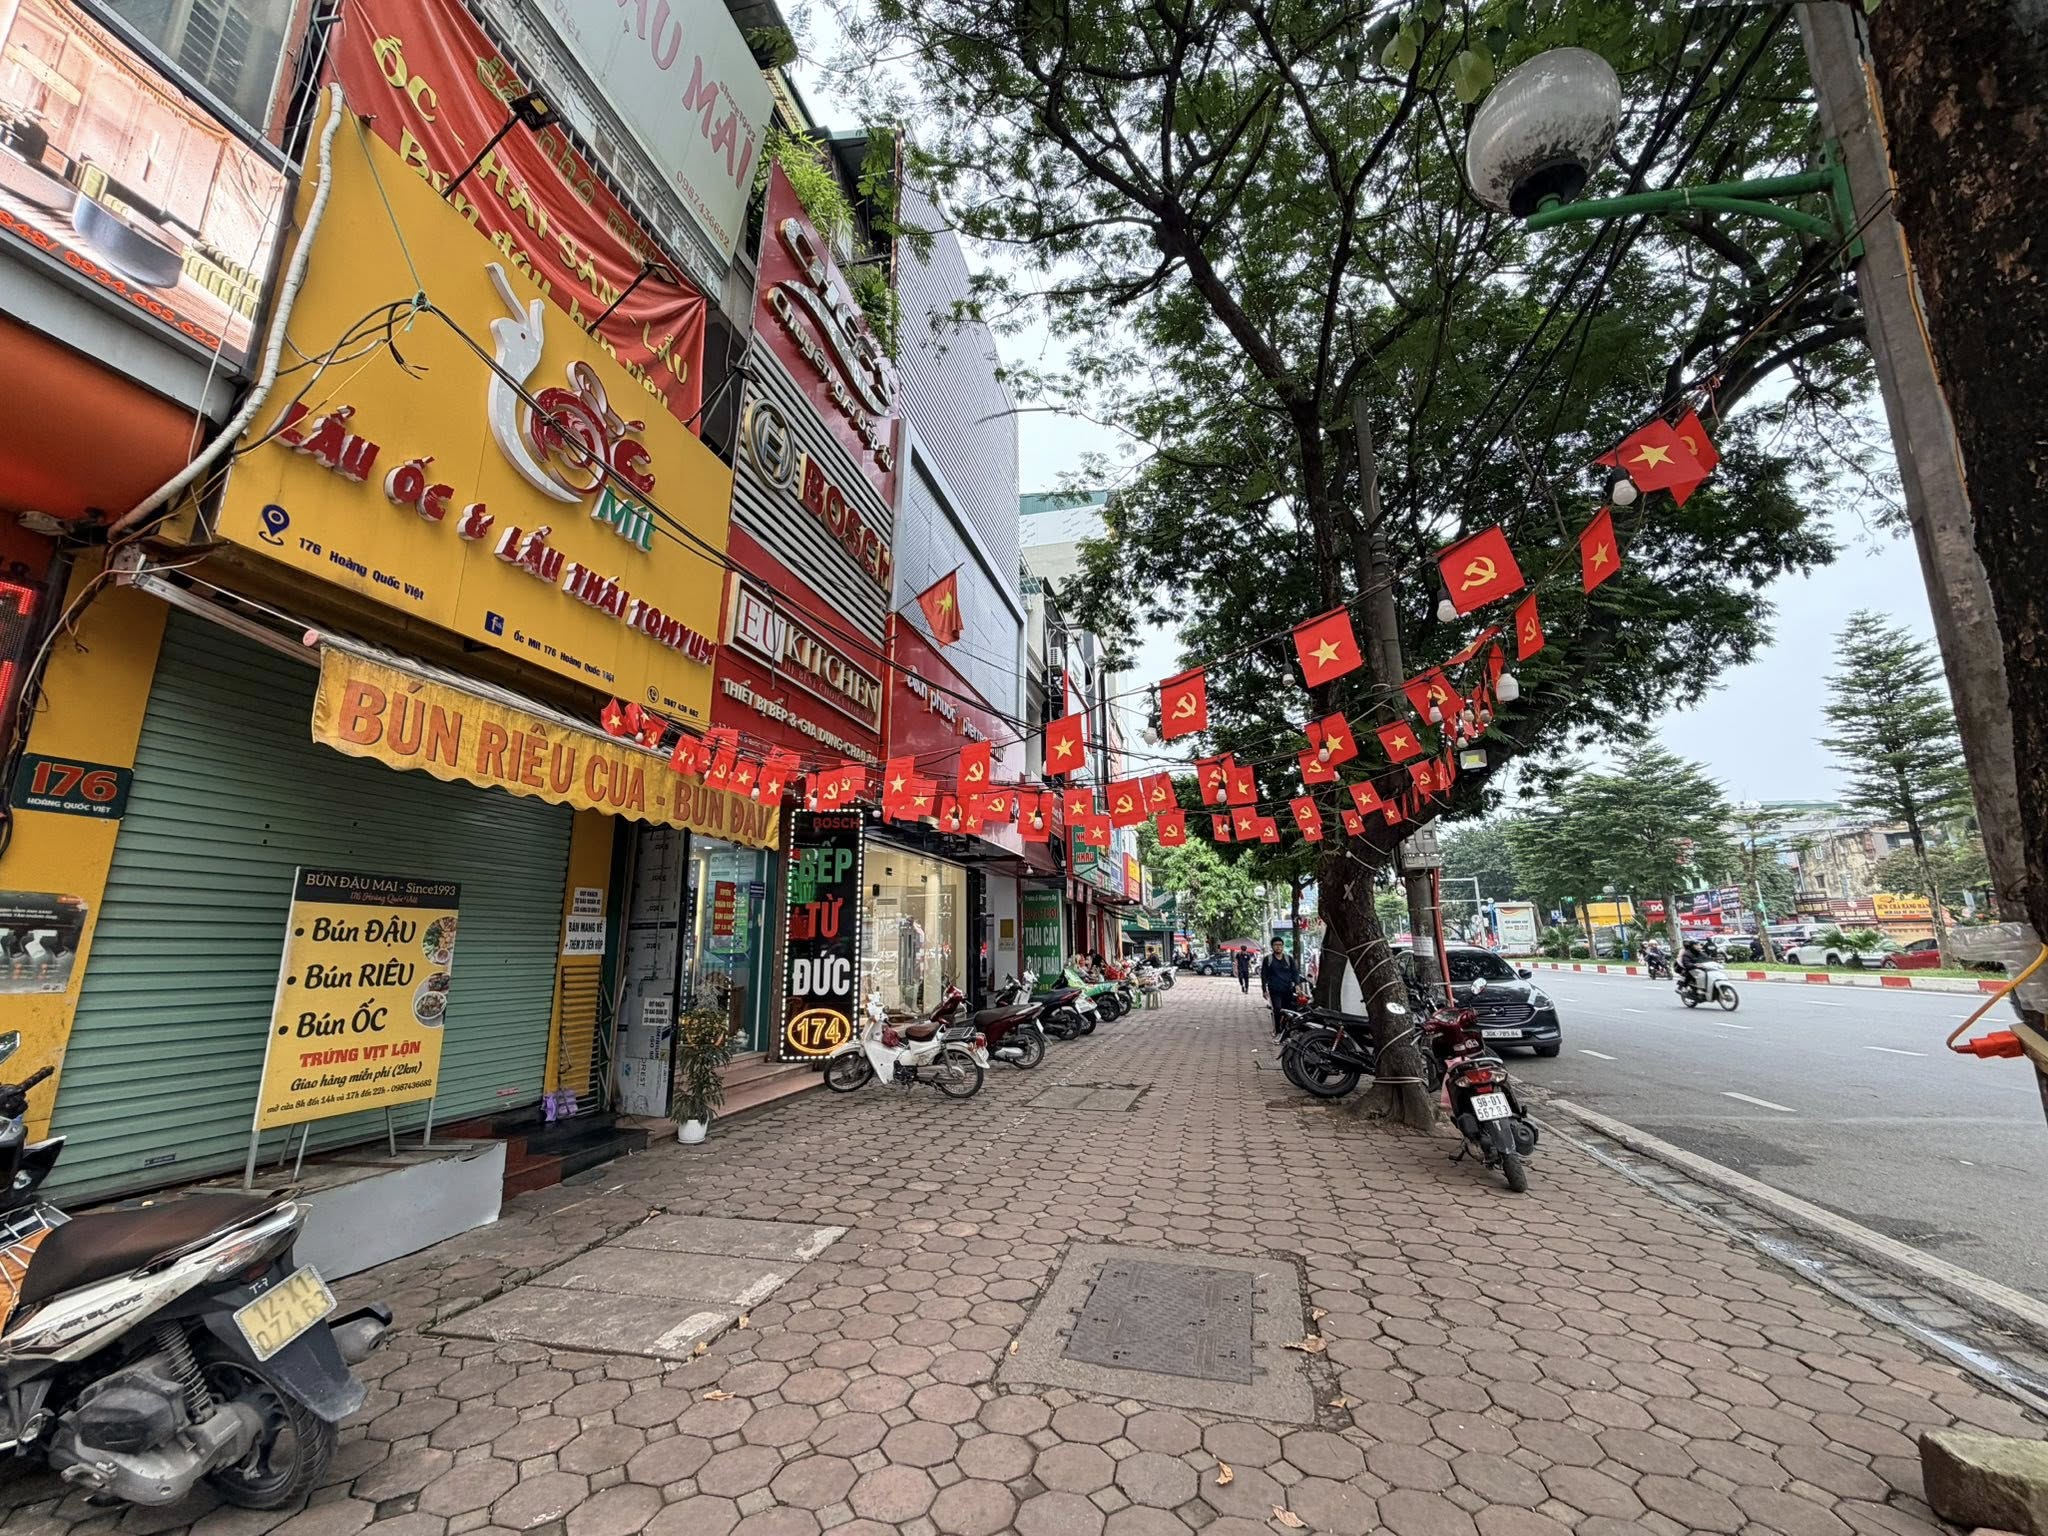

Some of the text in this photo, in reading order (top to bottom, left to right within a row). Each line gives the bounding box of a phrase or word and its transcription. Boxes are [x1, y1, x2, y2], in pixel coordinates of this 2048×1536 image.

[682, 55, 753, 190] MAI
[373, 35, 437, 122] ỐC
[478, 150, 548, 240] HẢI
[558, 232, 621, 315] SẢN
[641, 320, 688, 385] LẨU
[676, 169, 730, 249] 0987436682
[63, 250, 220, 350] 0934.665.622
[266, 400, 381, 482] LẨU
[385, 455, 455, 522] ỐC
[457, 502, 495, 542] &
[562, 562, 630, 619] THÁI
[627, 598, 718, 666] TOMYUM
[800, 453, 893, 592] BOSCH
[299, 537, 425, 601] 176 Hoàng Quốc Việt
[544, 645, 557, 657] 176
[720, 679, 756, 706] THIẾT
[769, 697, 789, 723] BẾP
[338, 679, 464, 768] BÚN
[475, 719, 576, 795] RIÊU
[583, 754, 647, 813] CUA
[27, 796, 61, 808] HOÀNG
[30, 761, 118, 802] 176
[813, 816, 859, 830] BOSCH
[799, 836, 853, 883] BẾP
[305, 872, 337, 888] BÚN
[340, 875, 371, 891] ĐẬU
[372, 879, 398, 893] MAI
[405, 882, 456, 897] Since1993
[312, 914, 417, 947] Bún ĐẬU
[805, 893, 845, 938] TỪ
[304, 957, 415, 989] Bún RIÊU
[792, 950, 850, 997] ĐỨC
[296, 998, 388, 1038] Bún ỐC
[797, 1017, 841, 1046] 174
[299, 1040, 422, 1068] TRỨNG VỊT LỘN
[290, 1060, 423, 1092] Giao hàng miễn phí (2km)
[321, 1094, 335, 1104] 14h
[345, 1091, 360, 1100] 17h
[372, 1086, 386, 1096] 22h
